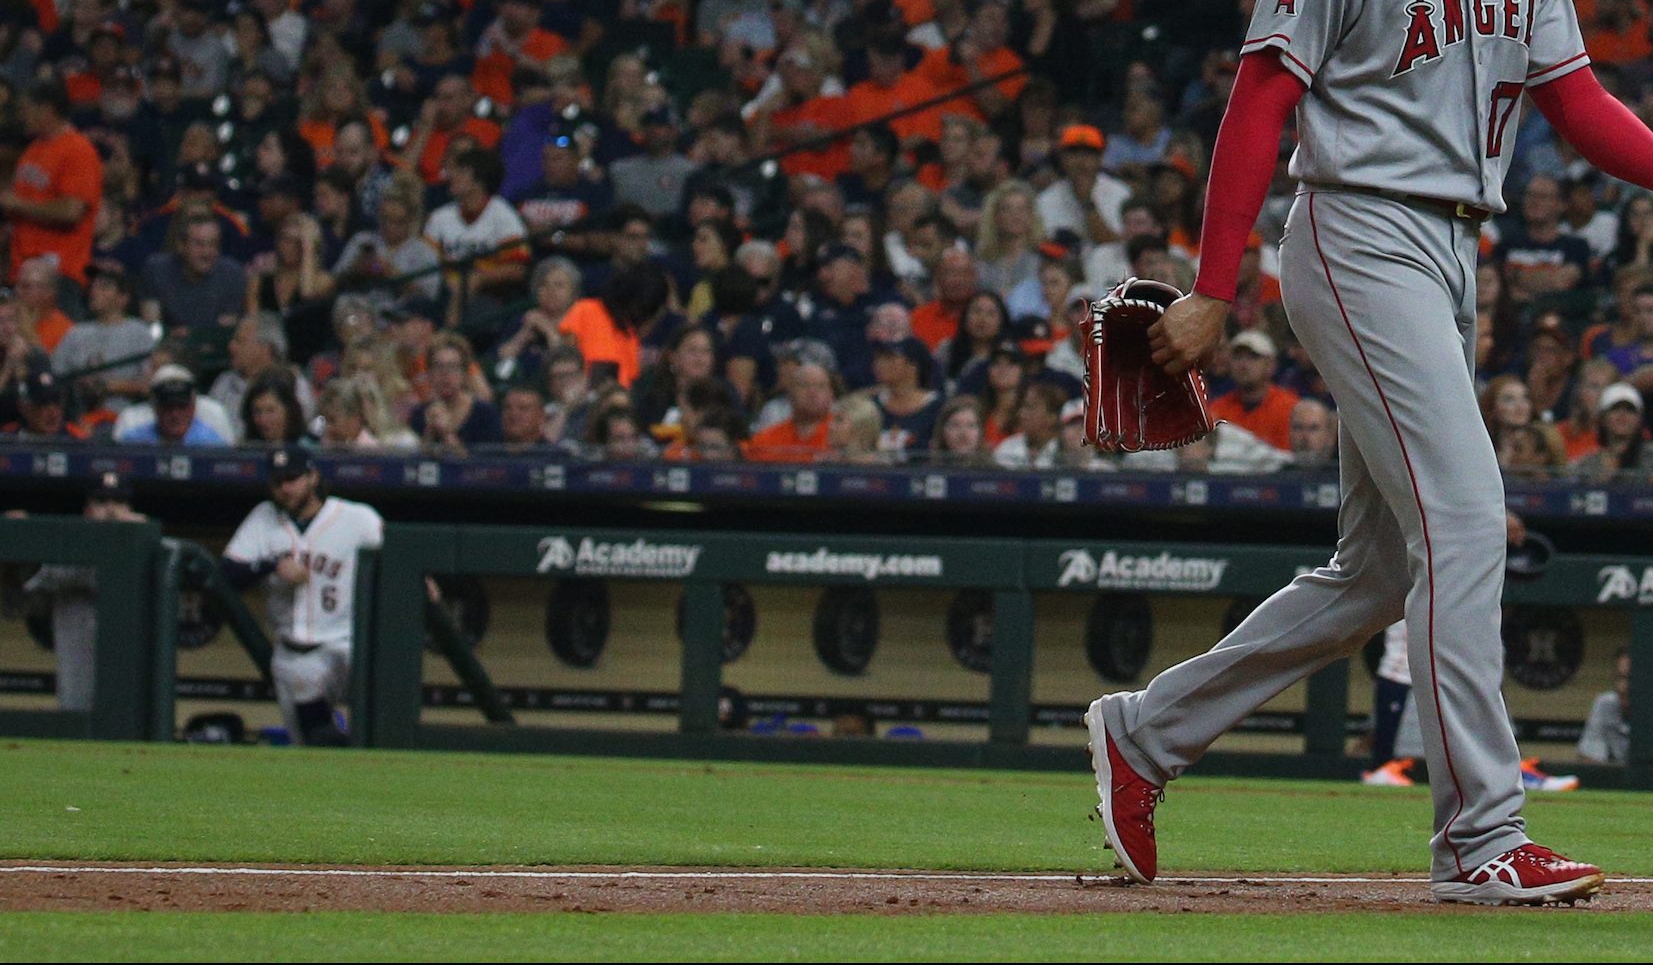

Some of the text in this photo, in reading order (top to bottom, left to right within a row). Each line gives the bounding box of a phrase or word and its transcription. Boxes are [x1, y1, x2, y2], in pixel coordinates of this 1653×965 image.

[575, 537, 703, 576] Academy
[766, 547, 943, 580] academy.com
[1097, 549, 1229, 590] Academy
